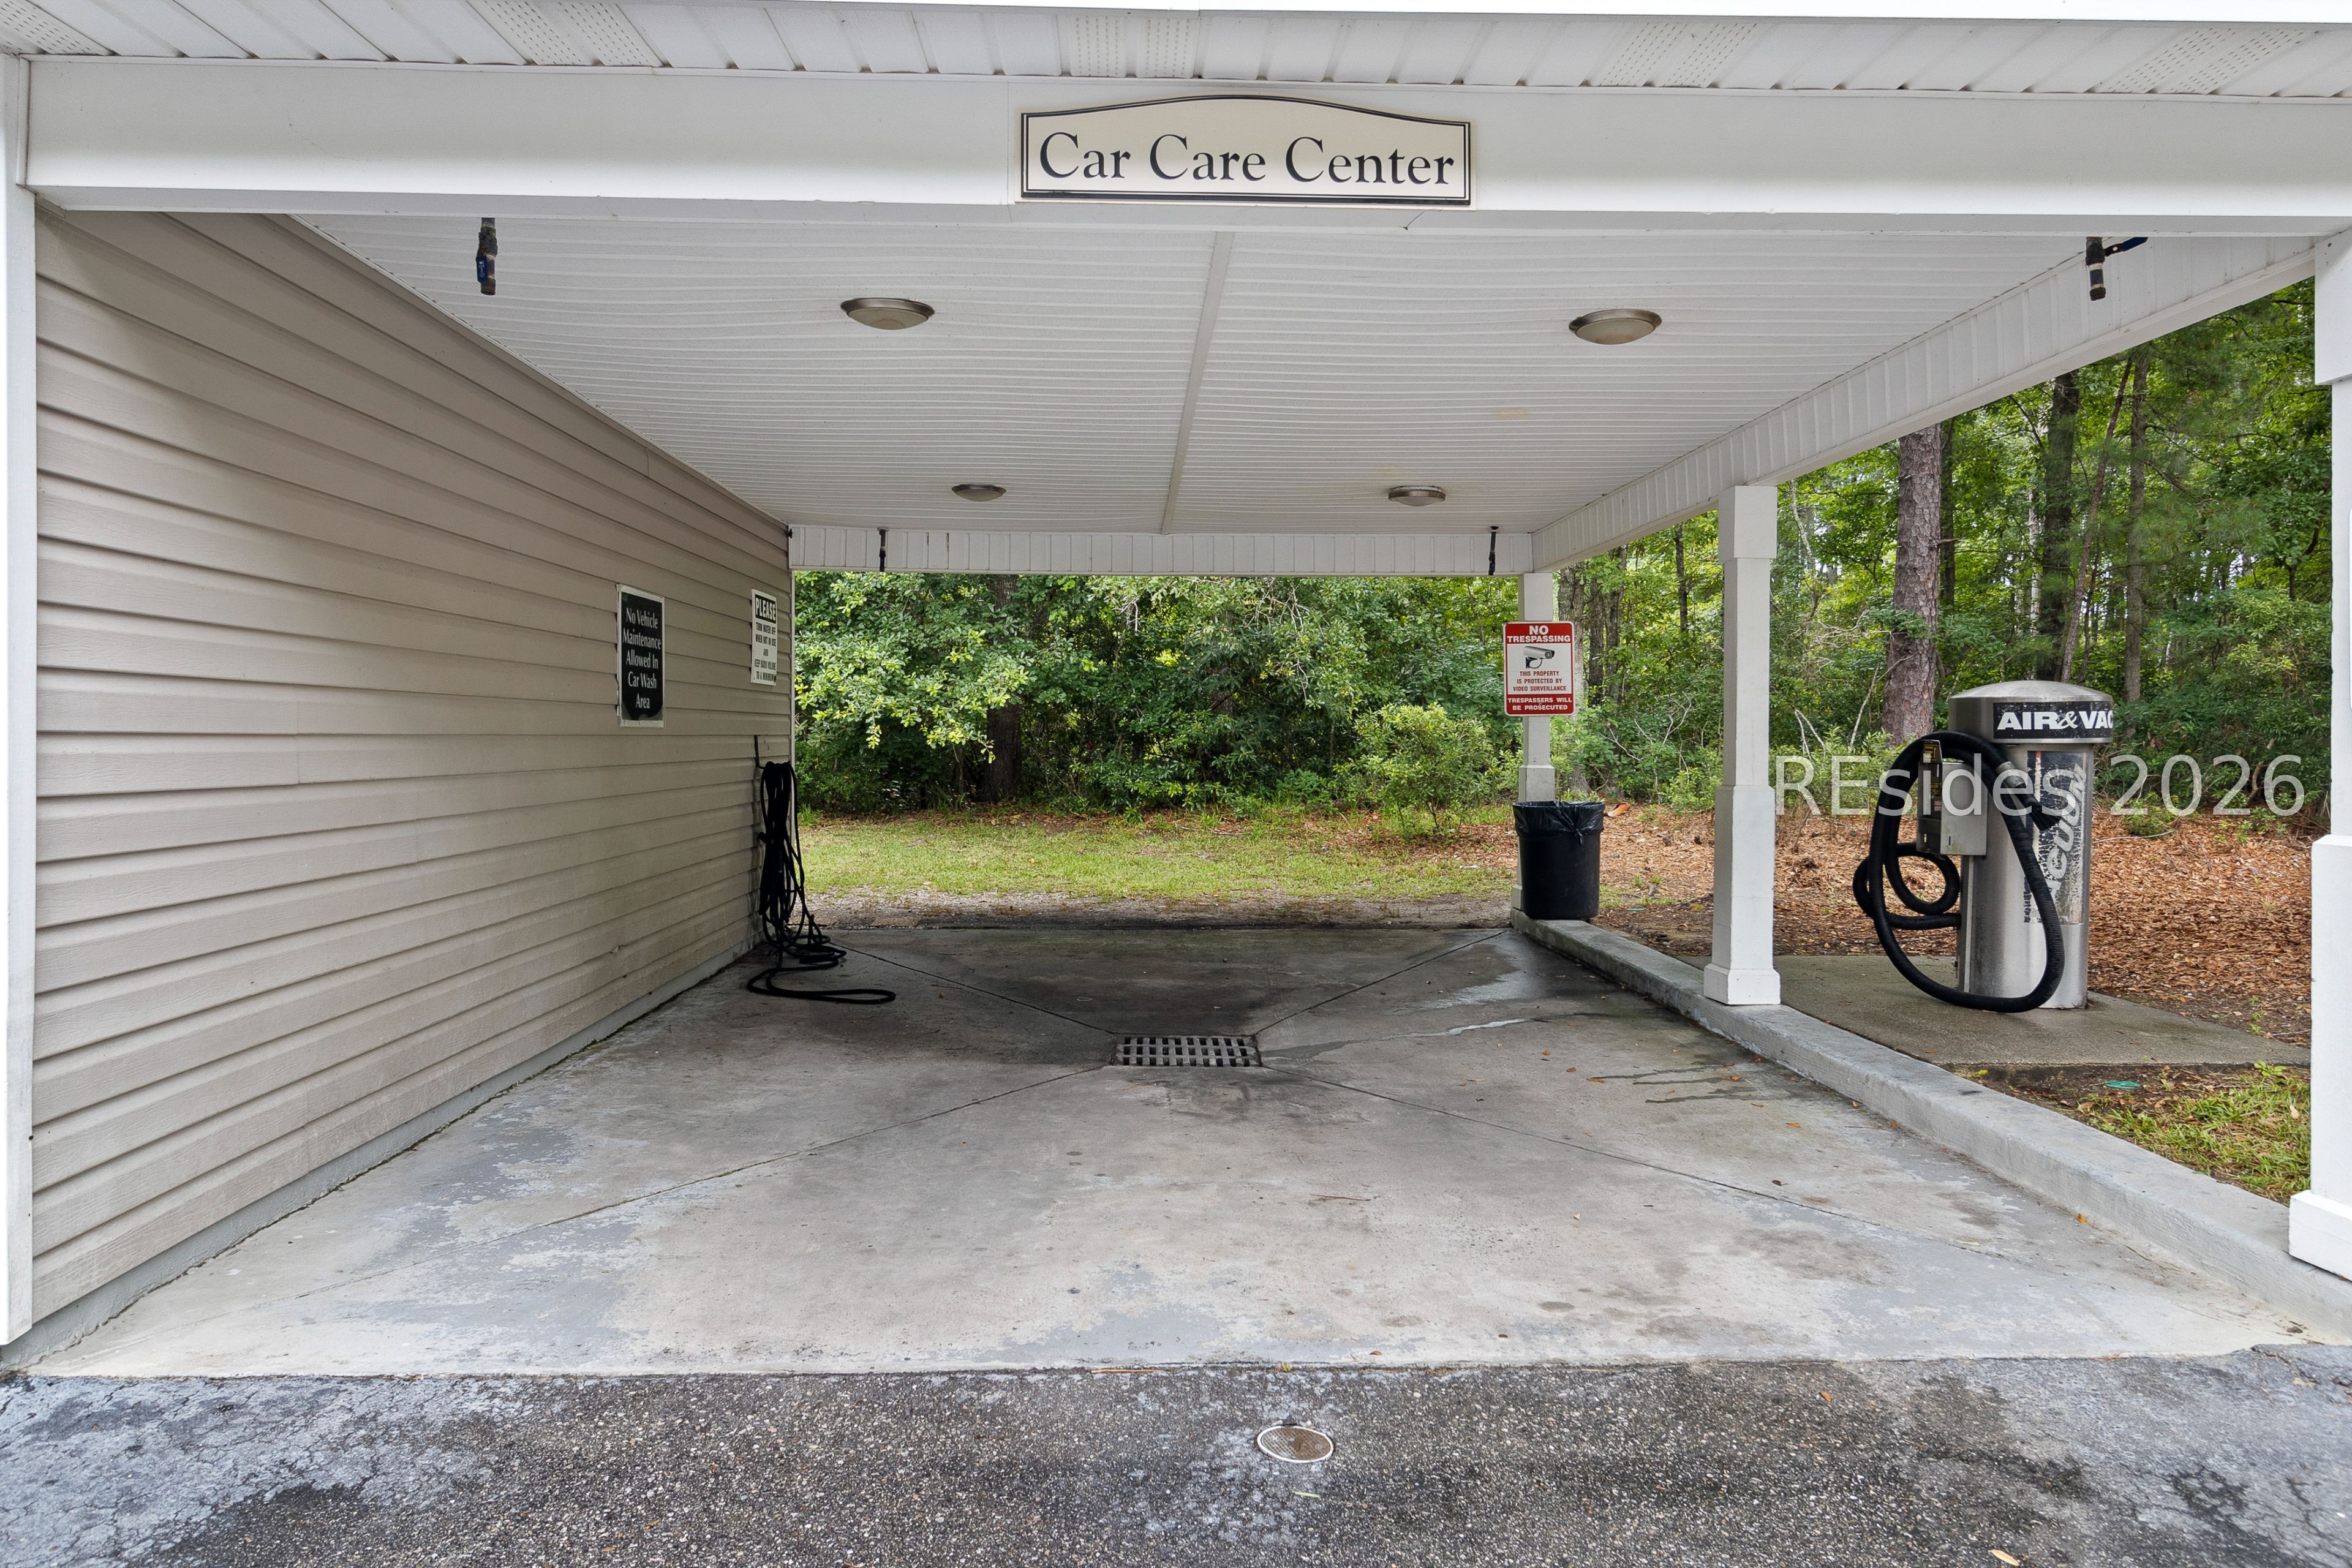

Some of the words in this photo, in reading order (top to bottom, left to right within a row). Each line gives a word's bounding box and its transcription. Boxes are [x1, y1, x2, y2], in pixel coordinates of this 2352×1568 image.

[1039, 132, 1131, 179] Car
[1149, 134, 1267, 182] Care
[1286, 136, 1455, 185] Center
[626, 607, 636, 624] No
[636, 609, 658, 630] Vehicle
[755, 597, 776, 621] PLEASE
[622, 628, 662, 650] Maintenance
[1529, 625, 1549, 635] NO
[626, 650, 651, 669] Allowed
[652, 654, 658, 669] In
[628, 671, 639, 687] Car
[640, 673, 657, 689] Wash
[635, 693, 650, 709] Area
